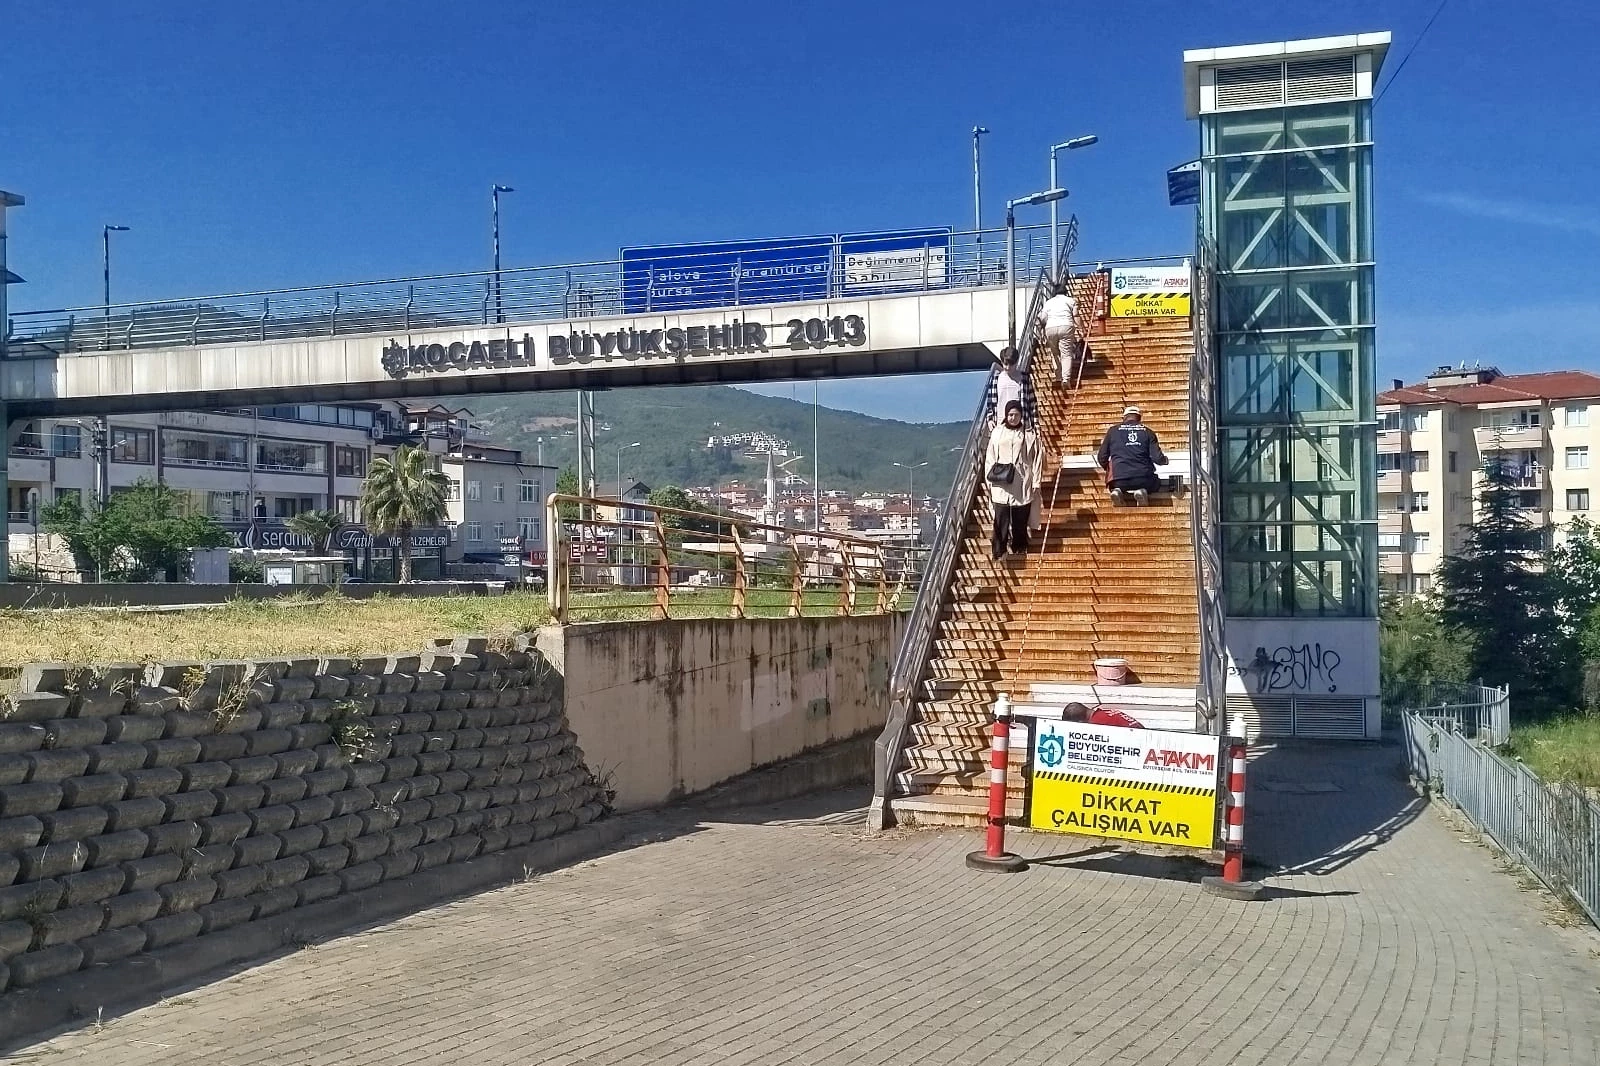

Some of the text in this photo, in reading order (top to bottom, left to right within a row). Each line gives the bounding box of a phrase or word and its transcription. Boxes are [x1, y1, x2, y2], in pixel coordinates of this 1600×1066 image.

[848, 252, 943, 267] Değirmendre
[1135, 299, 1164, 307] DİKKAT
[1125, 308, 1159, 316] ÇALIŞMA
[408, 314, 866, 368] KOCAELİ BÜYÜKŞEHİR 2013
[1068, 731, 1110, 743] KOCAELİ
[1068, 741, 1141, 757] BÜYÜKŞEHİR
[1067, 748, 1214, 771] BELEDİYESİ A-TAKIMI
[1082, 791, 1162, 816] DİKKAT
[1051, 809, 1190, 839] ÇALIŞMA VAR
